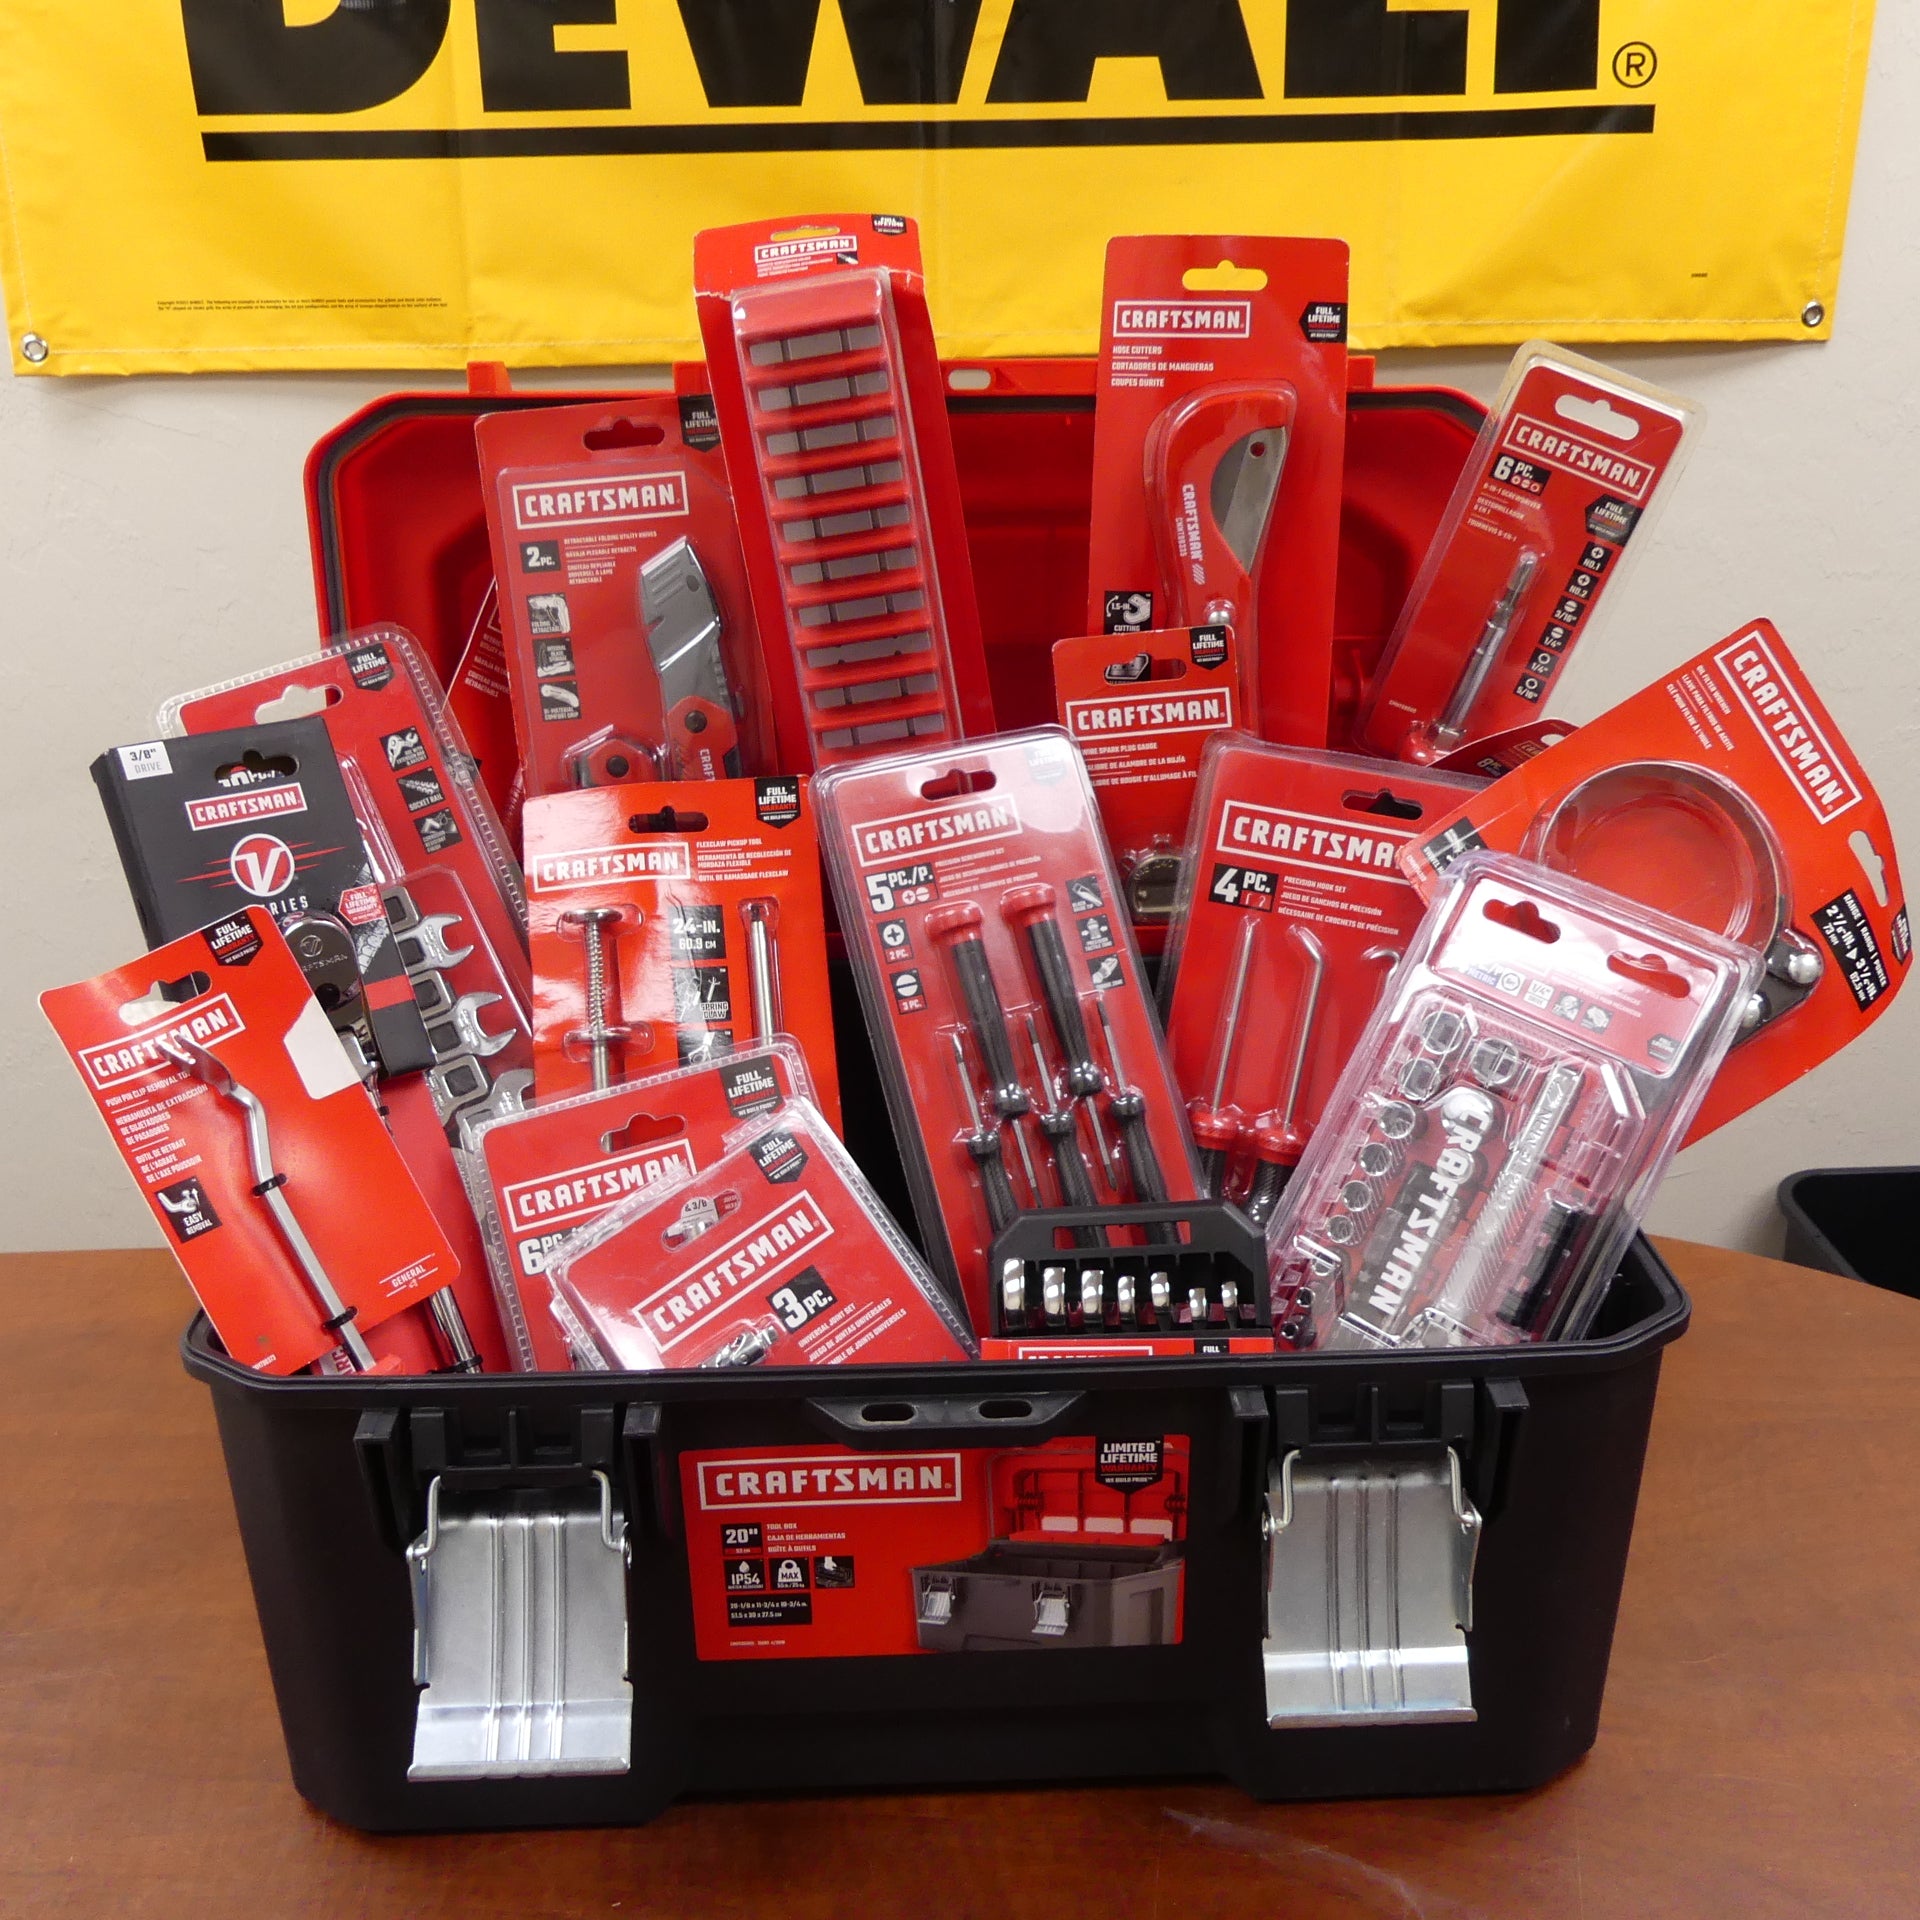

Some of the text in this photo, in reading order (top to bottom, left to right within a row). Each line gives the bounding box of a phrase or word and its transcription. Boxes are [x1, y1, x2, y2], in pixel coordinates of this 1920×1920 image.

[761, 239, 850, 259] CRAFTSMAN
[1121, 310, 1241, 329] CRAFTSMAN
[1307, 314, 1341, 324] LIFETIME
[1315, 306, 1334, 315] FULL
[1113, 346, 1162, 355] HOSE CUTTERS
[1112, 362, 1157, 371] CORTADORES
[1169, 362, 1214, 372] MANGUERAS
[1111, 378, 1137, 387] COUPES
[692, 411, 710, 420] FULL
[1516, 426, 1641, 488] CRAFTSMAN
[1494, 456, 1533, 480] 6 PC.
[524, 484, 675, 517] CRAFTSMAN
[1605, 502, 1623, 515] FULL
[1182, 484, 1203, 561] CRAFTSMAN
[1594, 506, 1628, 526] LIFETIME
[526, 546, 541, 567] 2
[1192, 640, 1225, 650] LIFETIME
[352, 656, 388, 674] LIFETIME
[357, 652, 377, 665] FULL
[1077, 699, 1220, 731] CRAFTSMAN
[1733, 650, 1844, 805] CRAFTSMAN
[130, 748, 157, 761] 3/8"
[1099, 742, 1158, 754] SPARK PLUG GAUGE
[135, 761, 162, 774] DRIVE
[758, 794, 797, 806] LIFETIME
[766, 786, 788, 796] FULL
[194, 790, 298, 822] CRAFTSMAN
[865, 806, 1010, 854] CRAFTSMAN
[696, 837, 762, 848] FLEXCLAW PICKUP TOOL
[1232, 816, 1402, 869] CRAFTSMA
[542, 851, 679, 882] CRAFTSMAN
[866, 873, 895, 914] 5
[888, 866, 934, 888] PC./P.
[1214, 868, 1271, 903] 4 PC.
[1283, 875, 1347, 893] PRECISION HOOK SET
[265, 895, 308, 915] RIES
[215, 921, 240, 937] FULL
[673, 917, 721, 935] 24-IN.
[1843, 893, 1862, 920] RANGE
[1860, 926, 1875, 953] RANGO
[211, 924, 253, 950] LIFETIME
[1467, 967, 1498, 986] METRIC
[702, 1002, 729, 1011] SPRING
[704, 1010, 727, 1019] CLAW
[735, 1070, 761, 1085] FULL
[105, 1096, 122, 1107] PUSH
[132, 1088, 147, 1098] CLIP
[146, 1076, 178, 1093] REMOVAL
[728, 1077, 775, 1098] LIFETIME
[759, 1138, 796, 1167] LIFETIME
[761, 1137, 783, 1155] FULL
[519, 1152, 690, 1217] CRAFTSMAN
[182, 1211, 204, 1226] EASY
[1368, 1109, 1491, 1317] CRAFTSMAN
[186, 1219, 213, 1235] REMOVAL
[519, 1238, 544, 1275] 6
[391, 1264, 427, 1288] GENERAL
[652, 1209, 816, 1333] CRAFTSMAN
[771, 1287, 833, 1329] 3 PC.
[798, 1302, 856, 1348] UNIVERSAL JOINT SET
[1203, 1345, 1220, 1354] FULL
[1103, 1442, 1155, 1453] LIMITED
[1100, 1453, 1158, 1464] LIFETIME
[1101, 1464, 1157, 1473] WARRANTY
[715, 1466, 942, 1497] CRAFTSMAN
[784, 1522, 797, 1530] BOX
[726, 1528, 758, 1544] 20"
[786, 1533, 795, 1541] DE
[795, 1532, 846, 1541] HERRAMIENTAS
[732, 1573, 760, 1585] IP54
[781, 1572, 799, 1580] MAX
